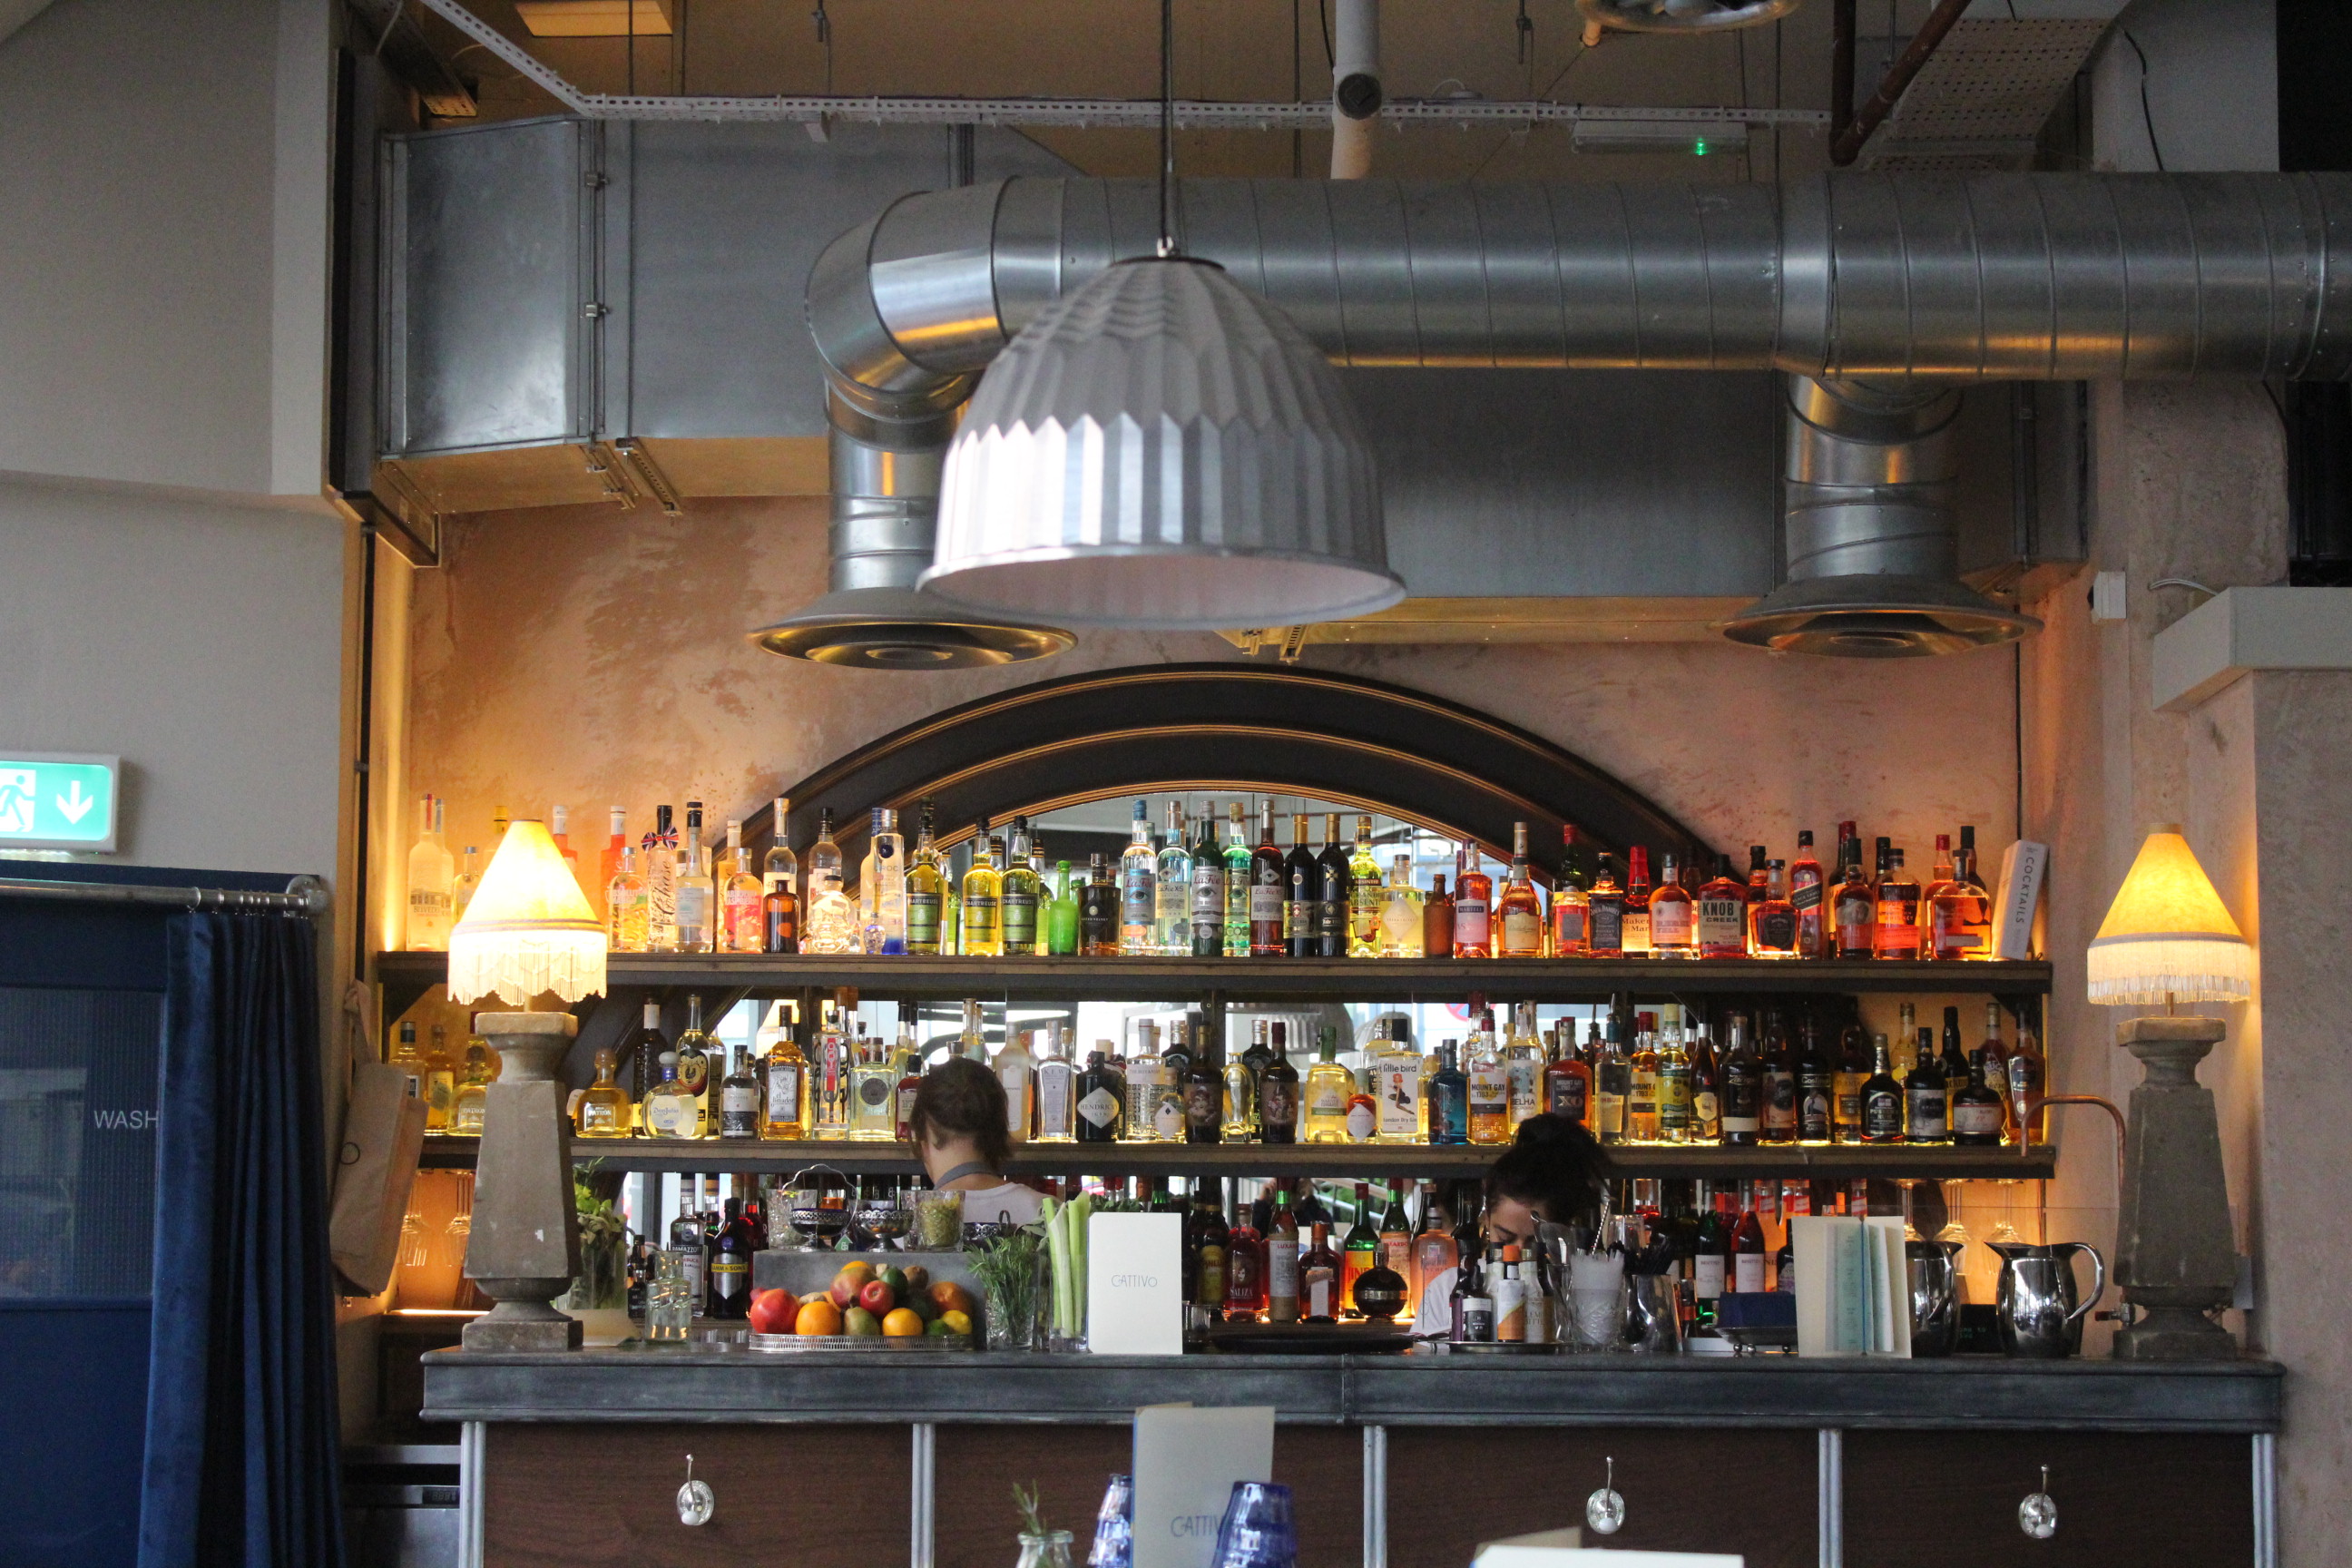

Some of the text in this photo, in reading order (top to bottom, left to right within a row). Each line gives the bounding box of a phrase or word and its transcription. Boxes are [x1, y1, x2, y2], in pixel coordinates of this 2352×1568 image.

[2016, 857, 2034, 924] COCKTAILS
[1702, 902, 1734, 916] KNOB
[1384, 1063, 1417, 1073] little bird
[1472, 1083, 1505, 1092] MOUNT GAY
[1558, 1095, 1583, 1107] XO
[93, 1110, 159, 1131] WASH
[1111, 1274, 1158, 1288] CATTIVO
[1171, 1515, 1228, 1538] CATTIV
